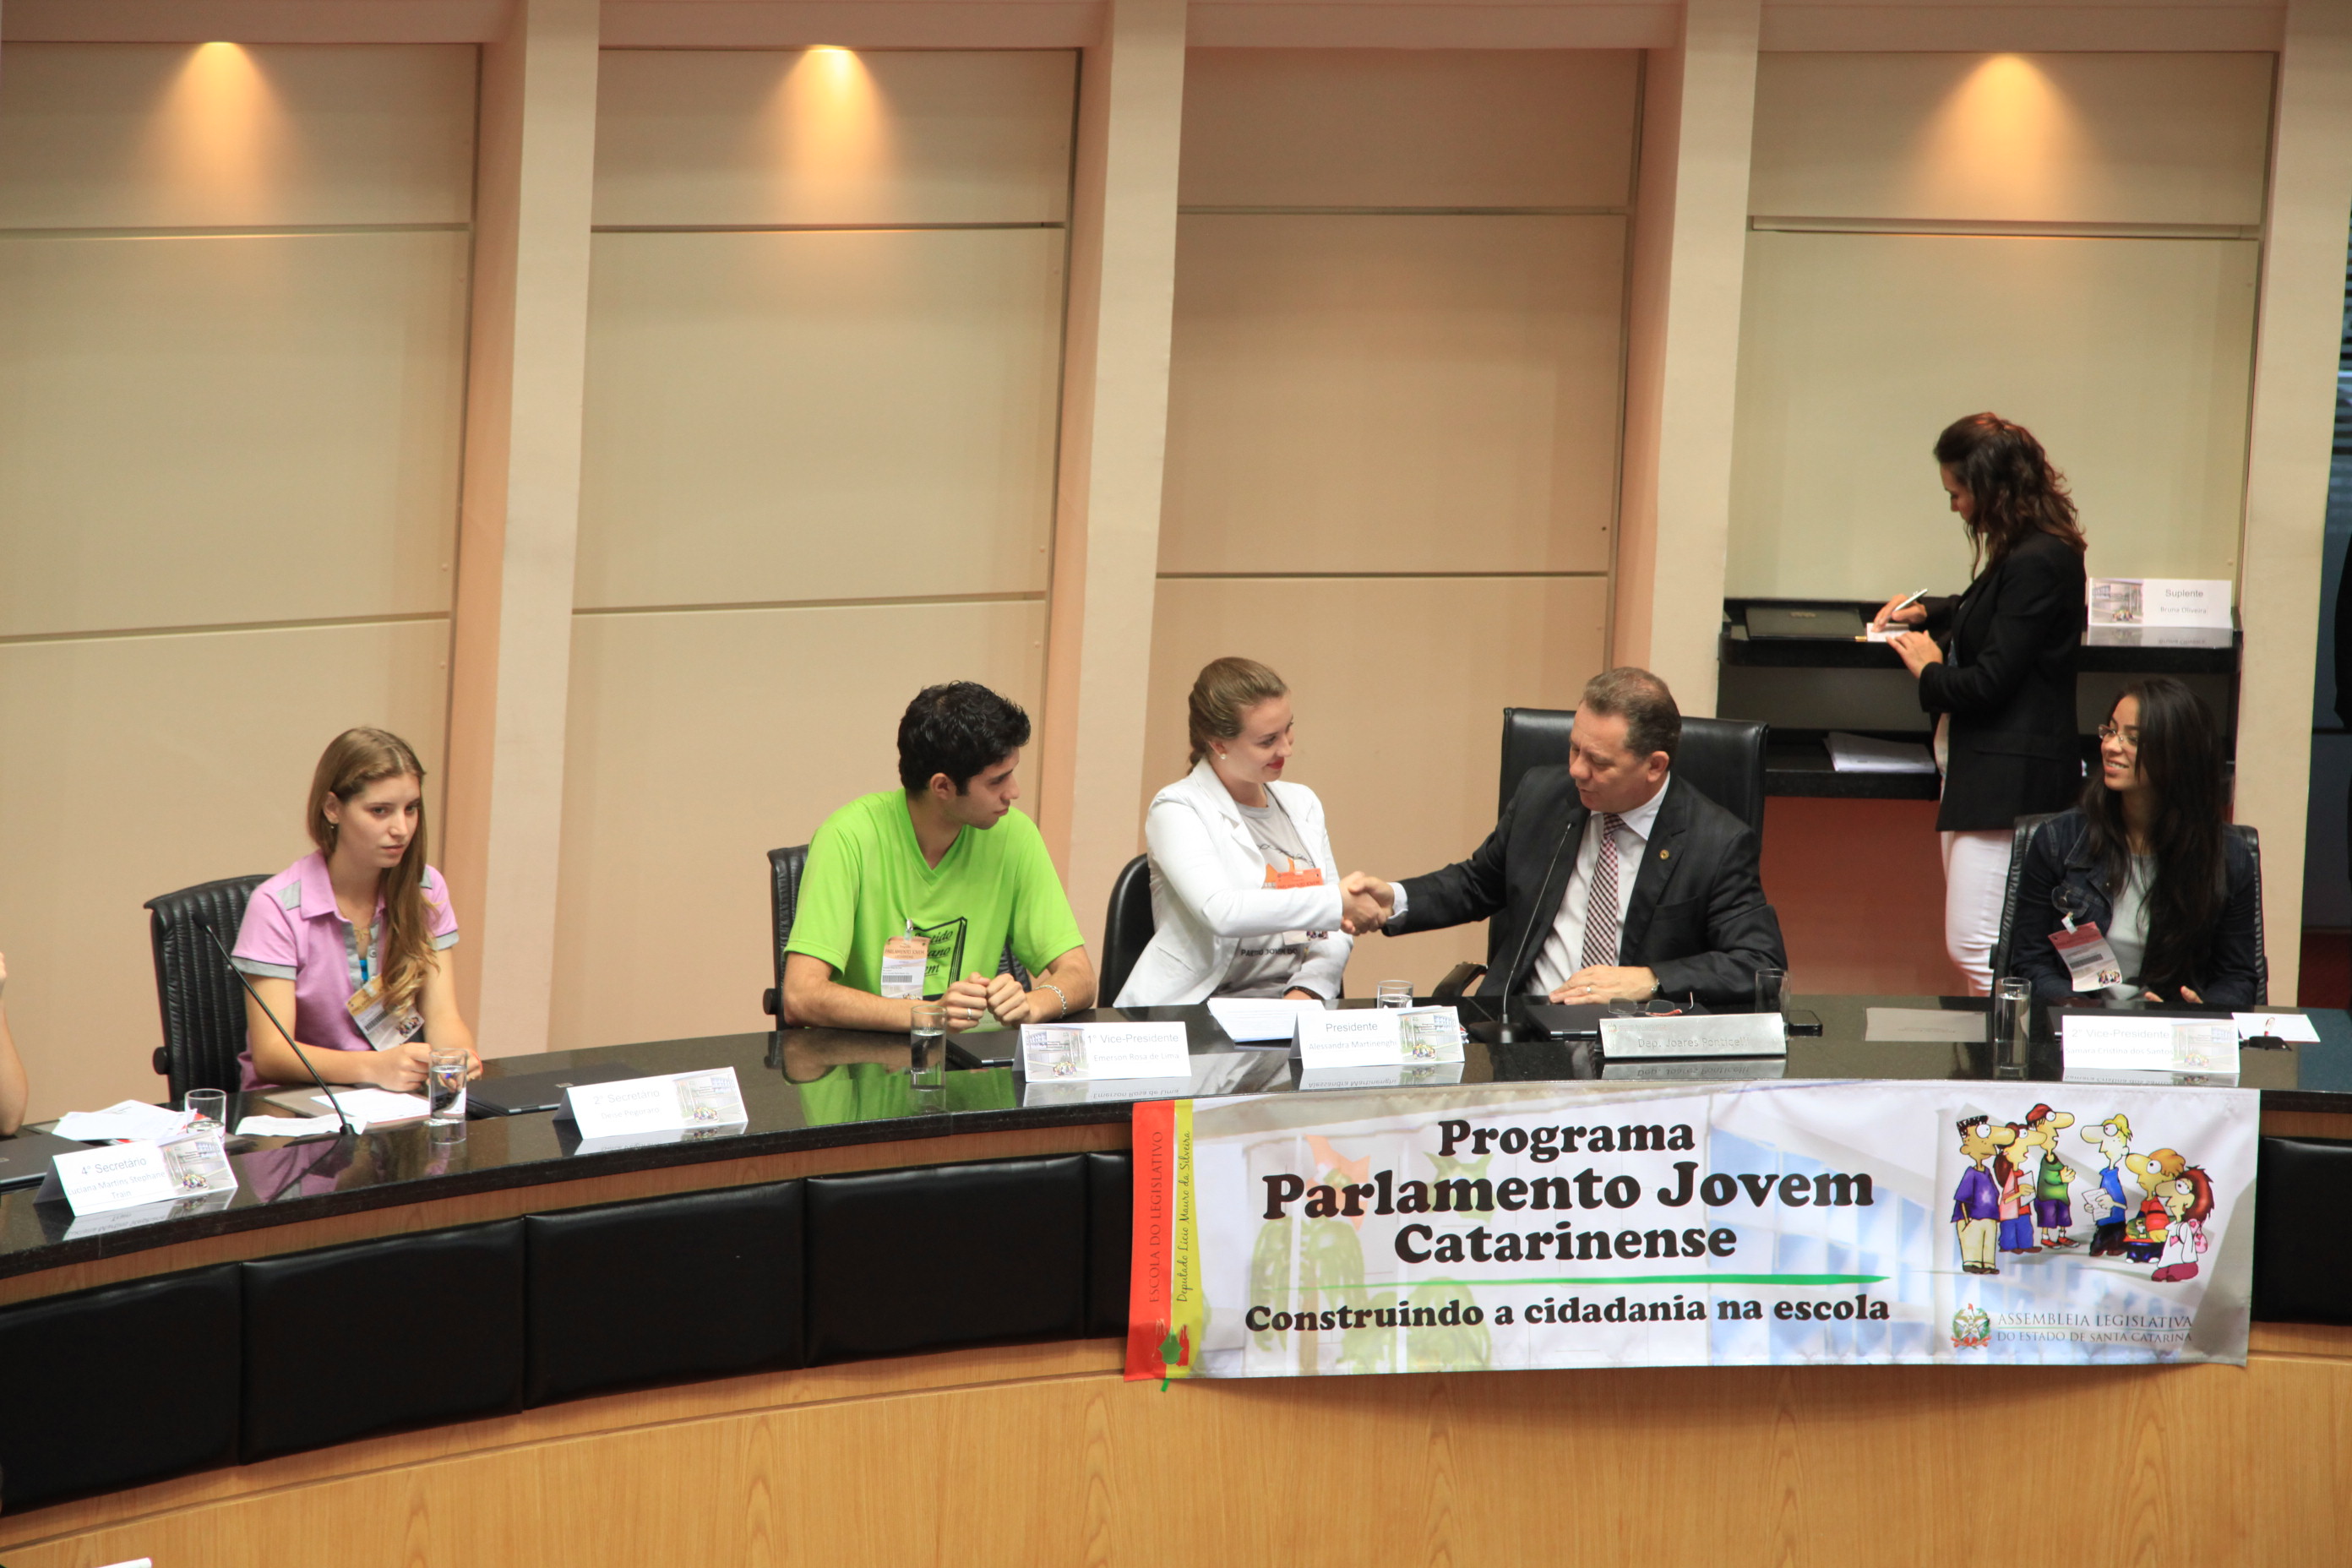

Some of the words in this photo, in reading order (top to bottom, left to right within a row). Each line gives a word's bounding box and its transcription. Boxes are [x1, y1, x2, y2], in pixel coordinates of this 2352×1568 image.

[2165, 589, 2204, 598] Suplente
[1326, 1022, 1378, 1032] Presidente
[2086, 1028, 2170, 1040] Vice-Presidente
[1100, 1033, 1179, 1043] Vice-Presidente
[1309, 1042, 1349, 1050] Alessandra
[1351, 1040, 1397, 1049] Martinenghi
[1638, 1038, 1662, 1048] Dep.
[1666, 1037, 1699, 1048] Joares
[1701, 1037, 1750, 1047] Ponticelli
[1093, 1054, 1127, 1062] Emerson
[1130, 1053, 1147, 1061] Rosa
[2098, 1047, 2128, 1055] Cristina
[2131, 1047, 2144, 1055] dos
[2146, 1048, 2174, 1056] Santos
[607, 1088, 661, 1104] Secretário
[1438, 1119, 1695, 1163] Programa
[1178, 1130, 1191, 1172] Silveira
[95, 1156, 147, 1174] Secretário
[1150, 1131, 1163, 1218] LEGISLATIVO
[1179, 1173, 1190, 1187] da
[67, 1184, 97, 1196] Luciana
[98, 1178, 128, 1190] Martins
[1262, 1168, 1641, 1219] Parlamento
[1657, 1161, 1874, 1207] Jovem
[1179, 1190, 1190, 1225] Mauro
[1150, 1224, 1162, 1245] DO
[1394, 1221, 1737, 1264] Catarinense
[1149, 1251, 1161, 1303] ESCOLA
[1176, 1255, 1194, 1302] Deputado
[1245, 1299, 1484, 1331] Construindo
[1494, 1305, 1514, 1326] a
[1524, 1294, 1707, 1324] cidadania
[1718, 1299, 1763, 1320] na
[1773, 1294, 1890, 1320] escola
[1998, 1312, 2090, 1326] ASSEMBLEIA
[2096, 1314, 2192, 1327] LEGISLATIVA
[1997, 1331, 2017, 1342] DO
[2019, 1331, 2066, 1342] ESTADO
[2071, 1331, 2085, 1342] DE
[2089, 1332, 2128, 1342] SANTA
[2131, 1331, 2192, 1343] CATARINA
